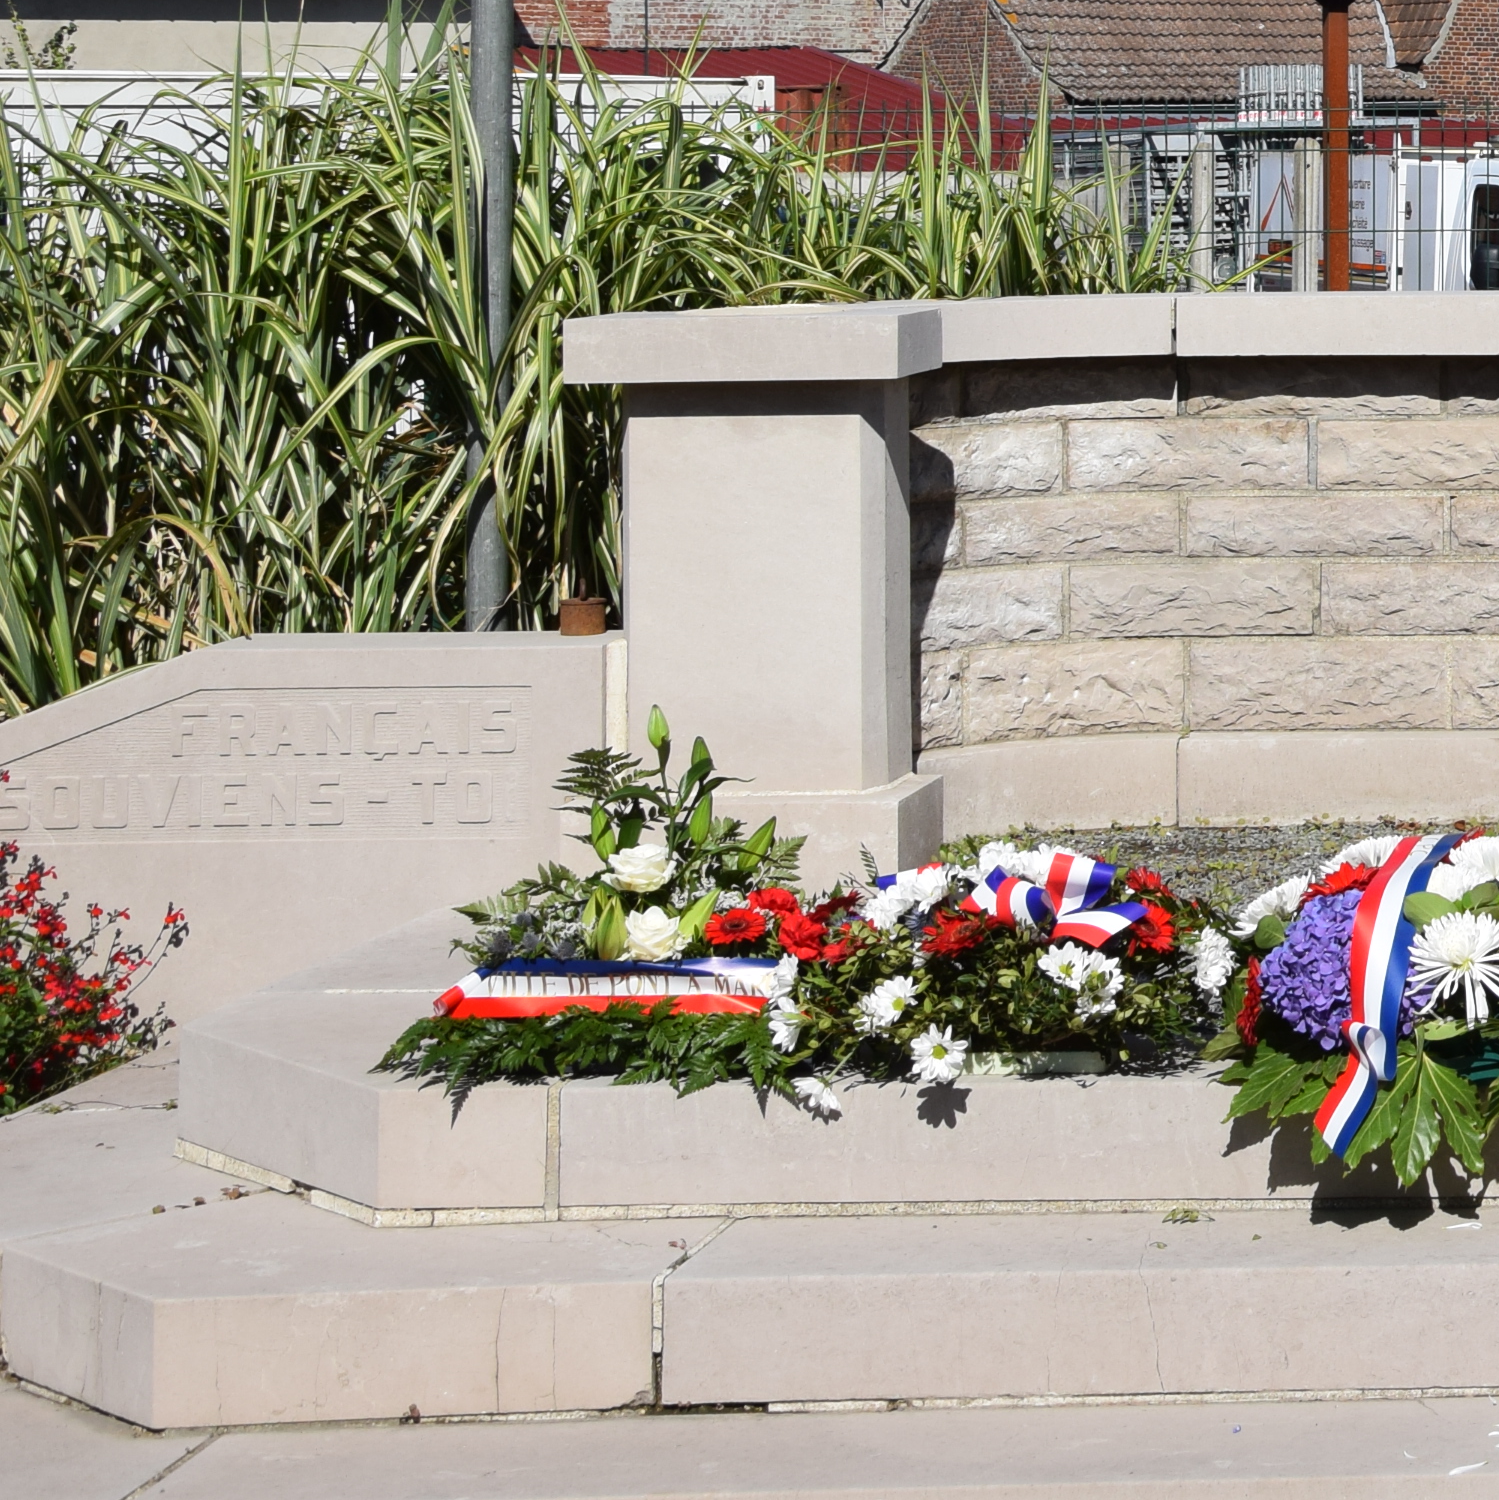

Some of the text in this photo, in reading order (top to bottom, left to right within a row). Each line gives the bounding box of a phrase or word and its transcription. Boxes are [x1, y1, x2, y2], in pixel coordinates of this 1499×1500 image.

[171, 700, 518, 761] FRANÇAIS
[488, 970, 671, 997] VILLE DE PONT
